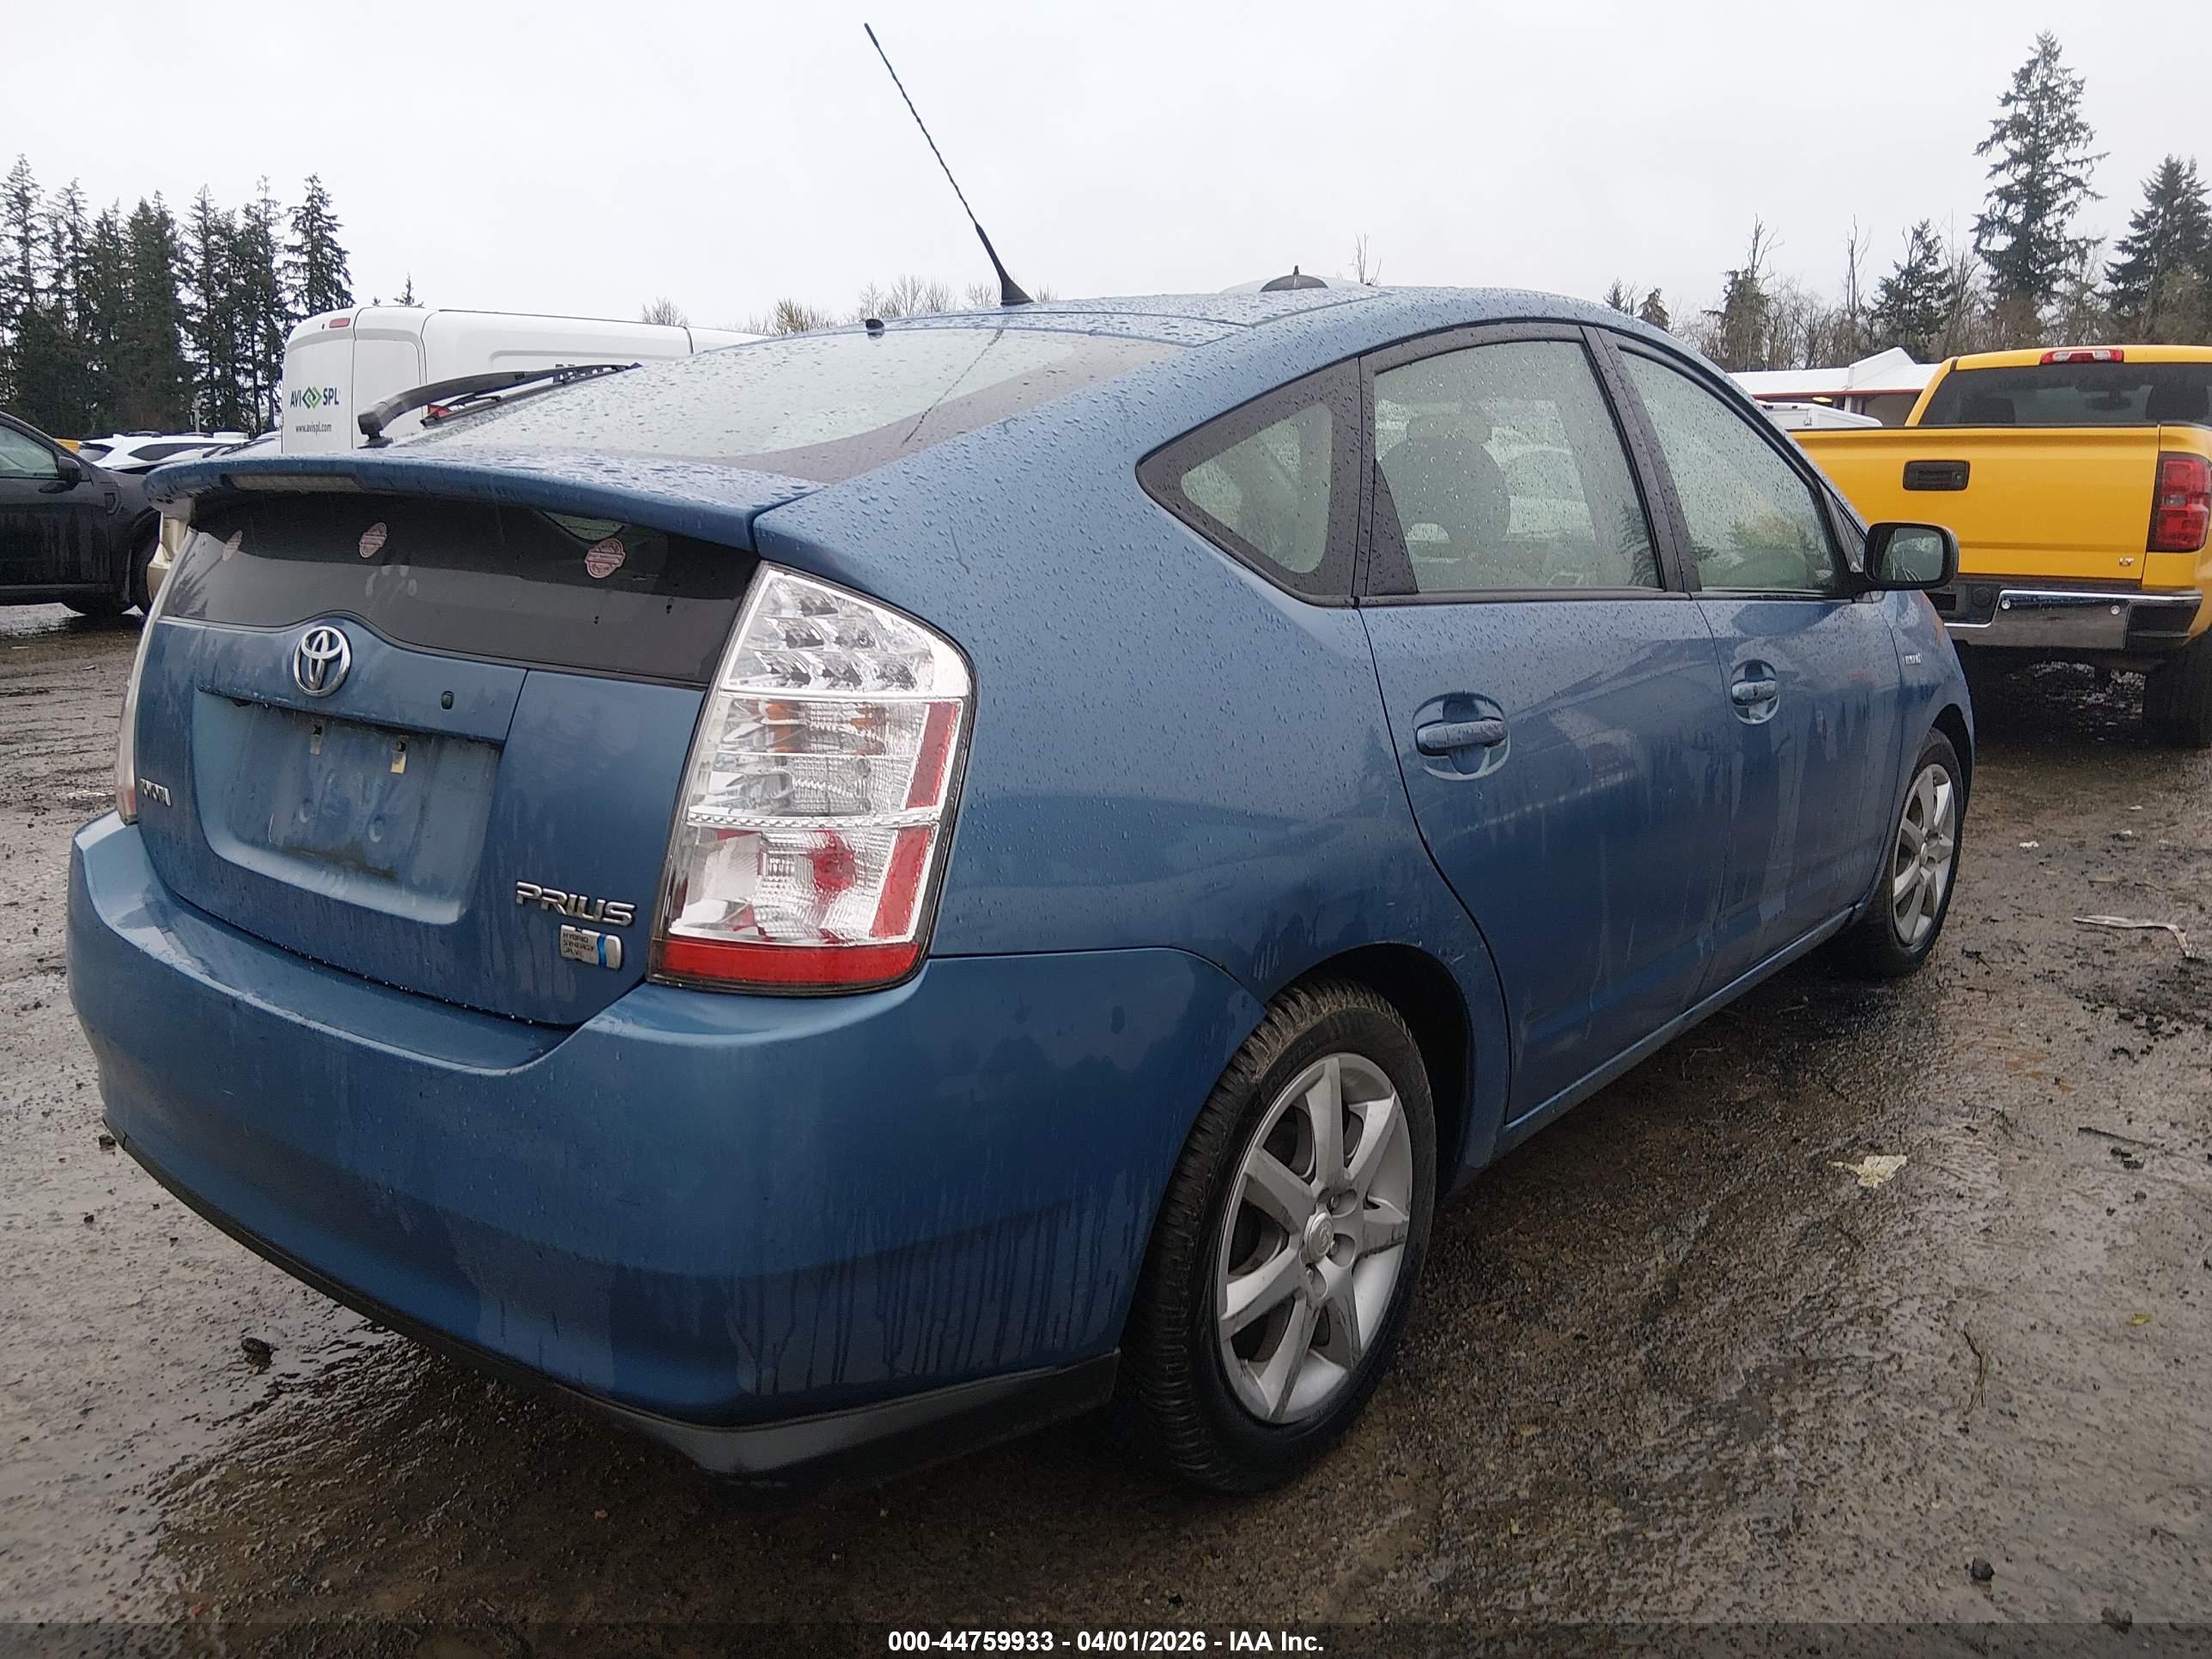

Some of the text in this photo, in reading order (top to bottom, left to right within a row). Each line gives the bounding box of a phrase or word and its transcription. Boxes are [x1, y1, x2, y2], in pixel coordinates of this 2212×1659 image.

[290, 387, 339, 409] AVI SPL
[295, 421, 331, 436] www.avispl.com
[515, 880, 637, 927] PRIUS
